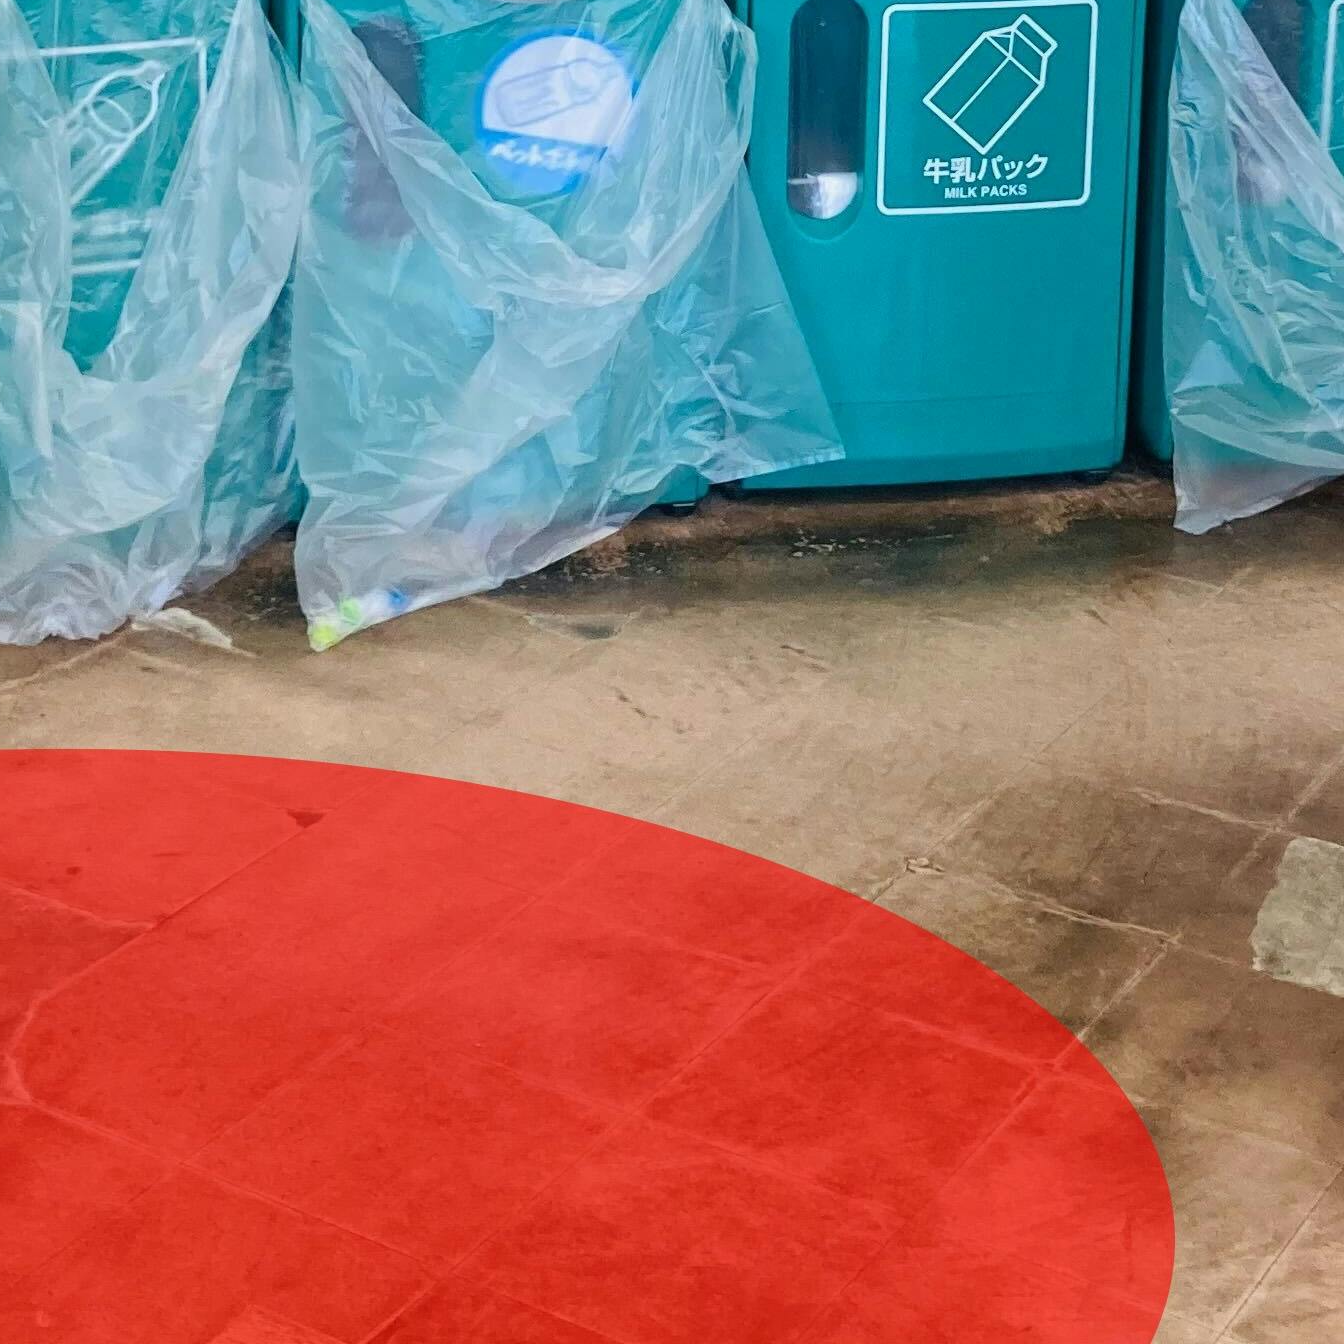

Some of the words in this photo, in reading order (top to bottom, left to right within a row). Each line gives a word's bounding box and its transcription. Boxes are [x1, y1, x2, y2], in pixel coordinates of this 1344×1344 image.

[923, 154, 1049, 184] 牛乳パック
[944, 187, 978, 199] MILK
[980, 184, 1028, 198] PACKS
